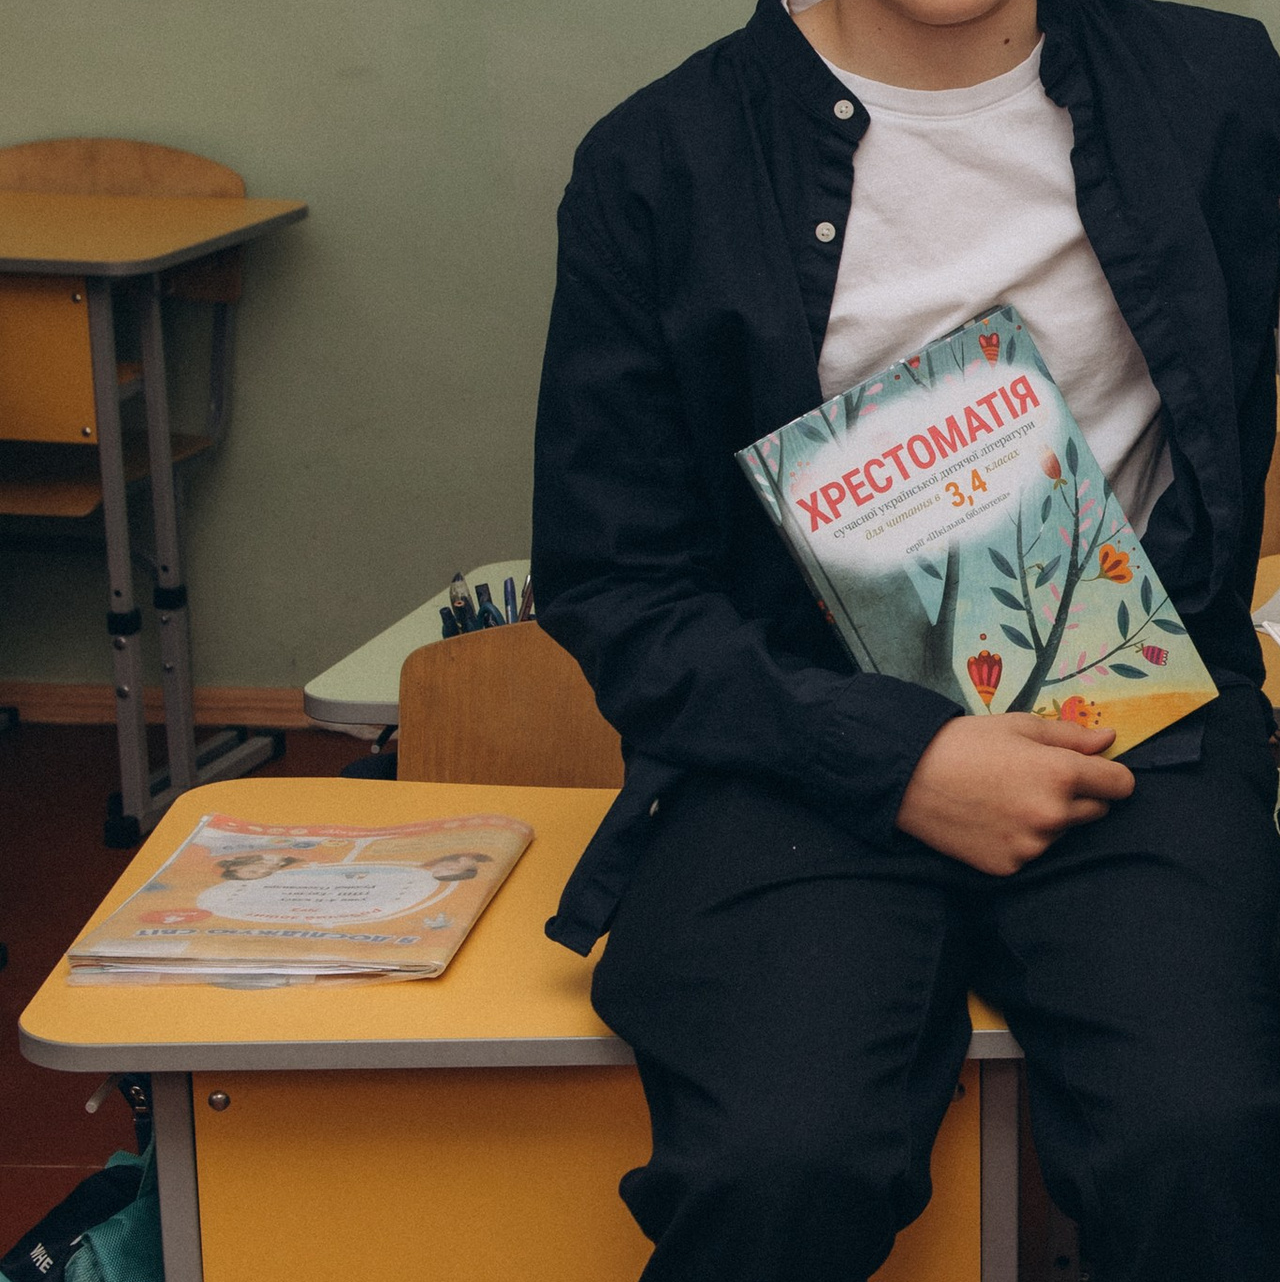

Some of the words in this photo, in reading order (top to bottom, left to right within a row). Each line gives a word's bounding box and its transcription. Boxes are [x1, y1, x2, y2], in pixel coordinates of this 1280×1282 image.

[796, 375, 1040, 533] ХРЕСТОМАТІЯ
[833, 508, 879, 539] сучасної
[879, 476, 938, 518] української
[940, 450, 979, 484] дитячої
[980, 420, 1036, 458] літератури
[865, 525, 885, 541] для
[885, 499, 933, 530] читання
[934, 494, 942, 503] в
[945, 468, 988, 509] 3,4
[985, 448, 1021, 474] класах
[905, 537, 926, 555] серії
[965, 491, 1012, 521] бібліотека»
